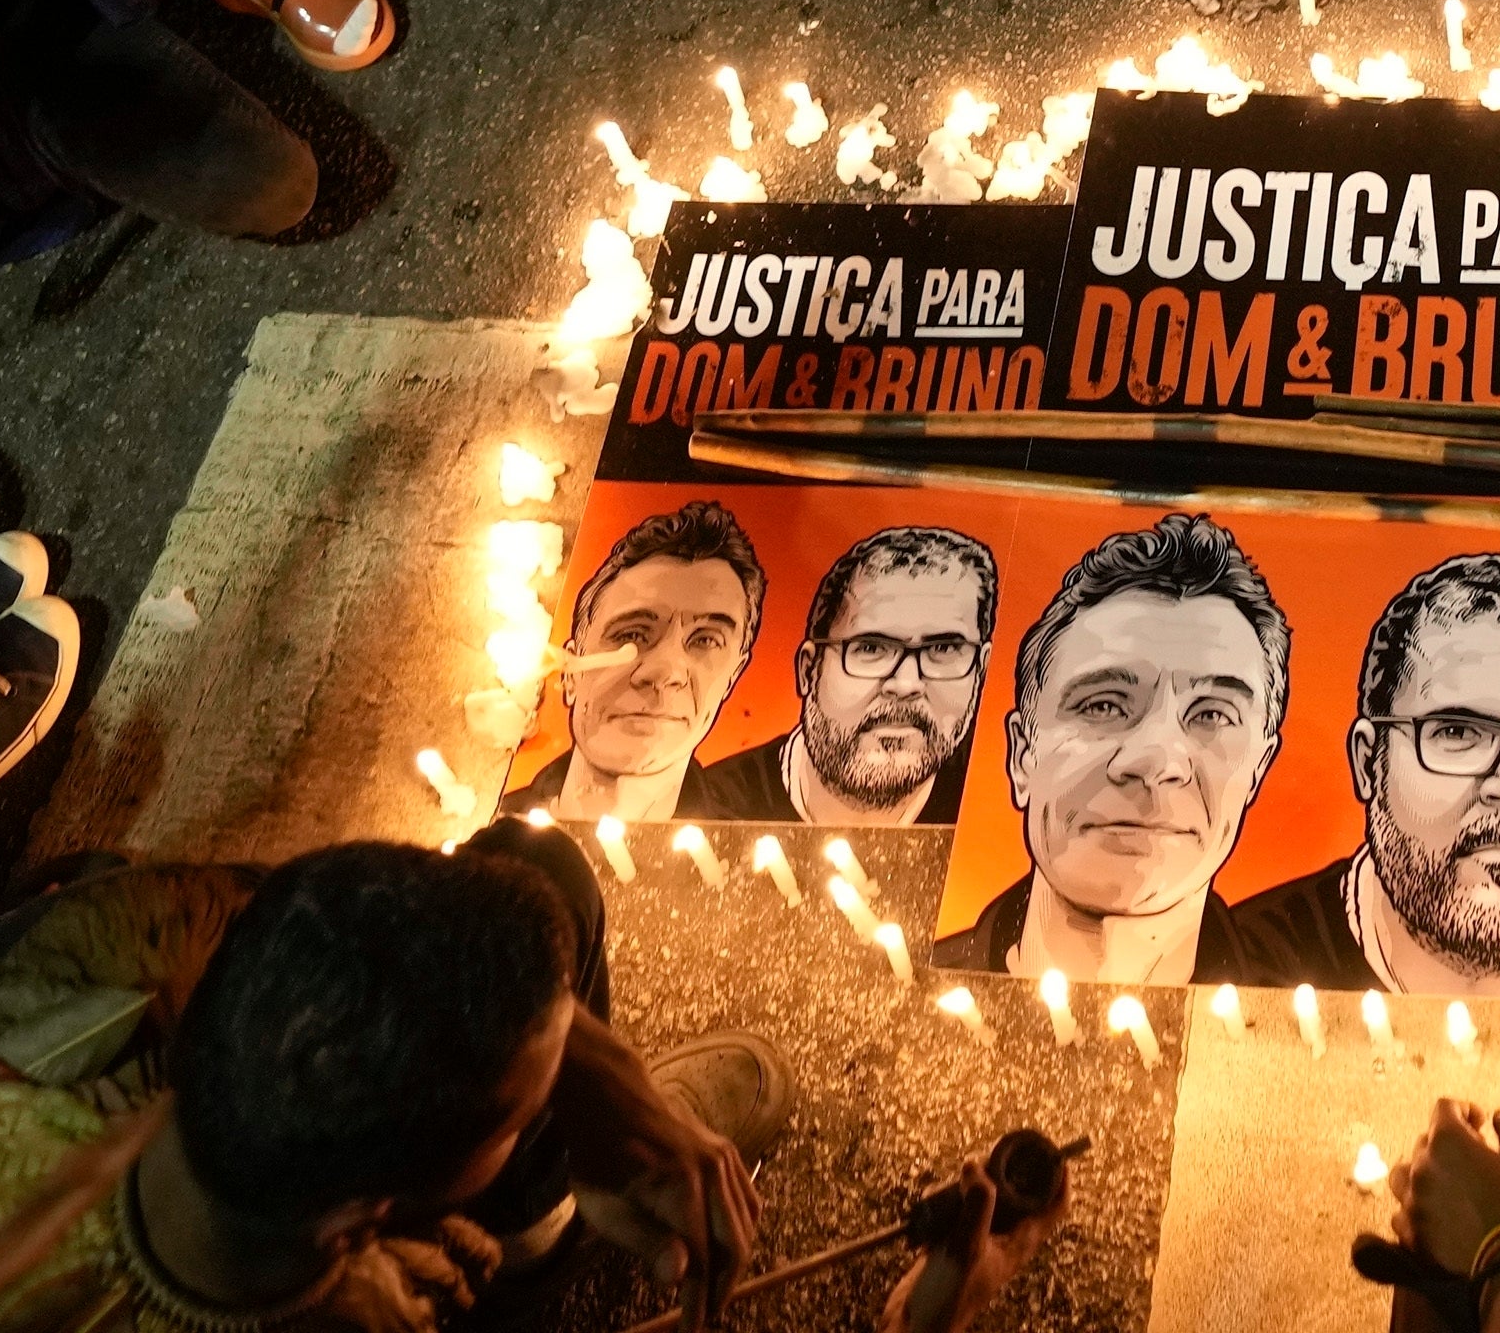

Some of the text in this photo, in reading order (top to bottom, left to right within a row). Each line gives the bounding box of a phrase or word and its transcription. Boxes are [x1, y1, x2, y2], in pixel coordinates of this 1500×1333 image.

[1091, 166, 1439, 292] JUSTIÇA
[655, 253, 1025, 344] JUSTIÇA PARA
[1066, 286, 1275, 407] DOM
[1285, 304, 1331, 380] &
[628, 339, 1046, 425] DOM & BRUNO
